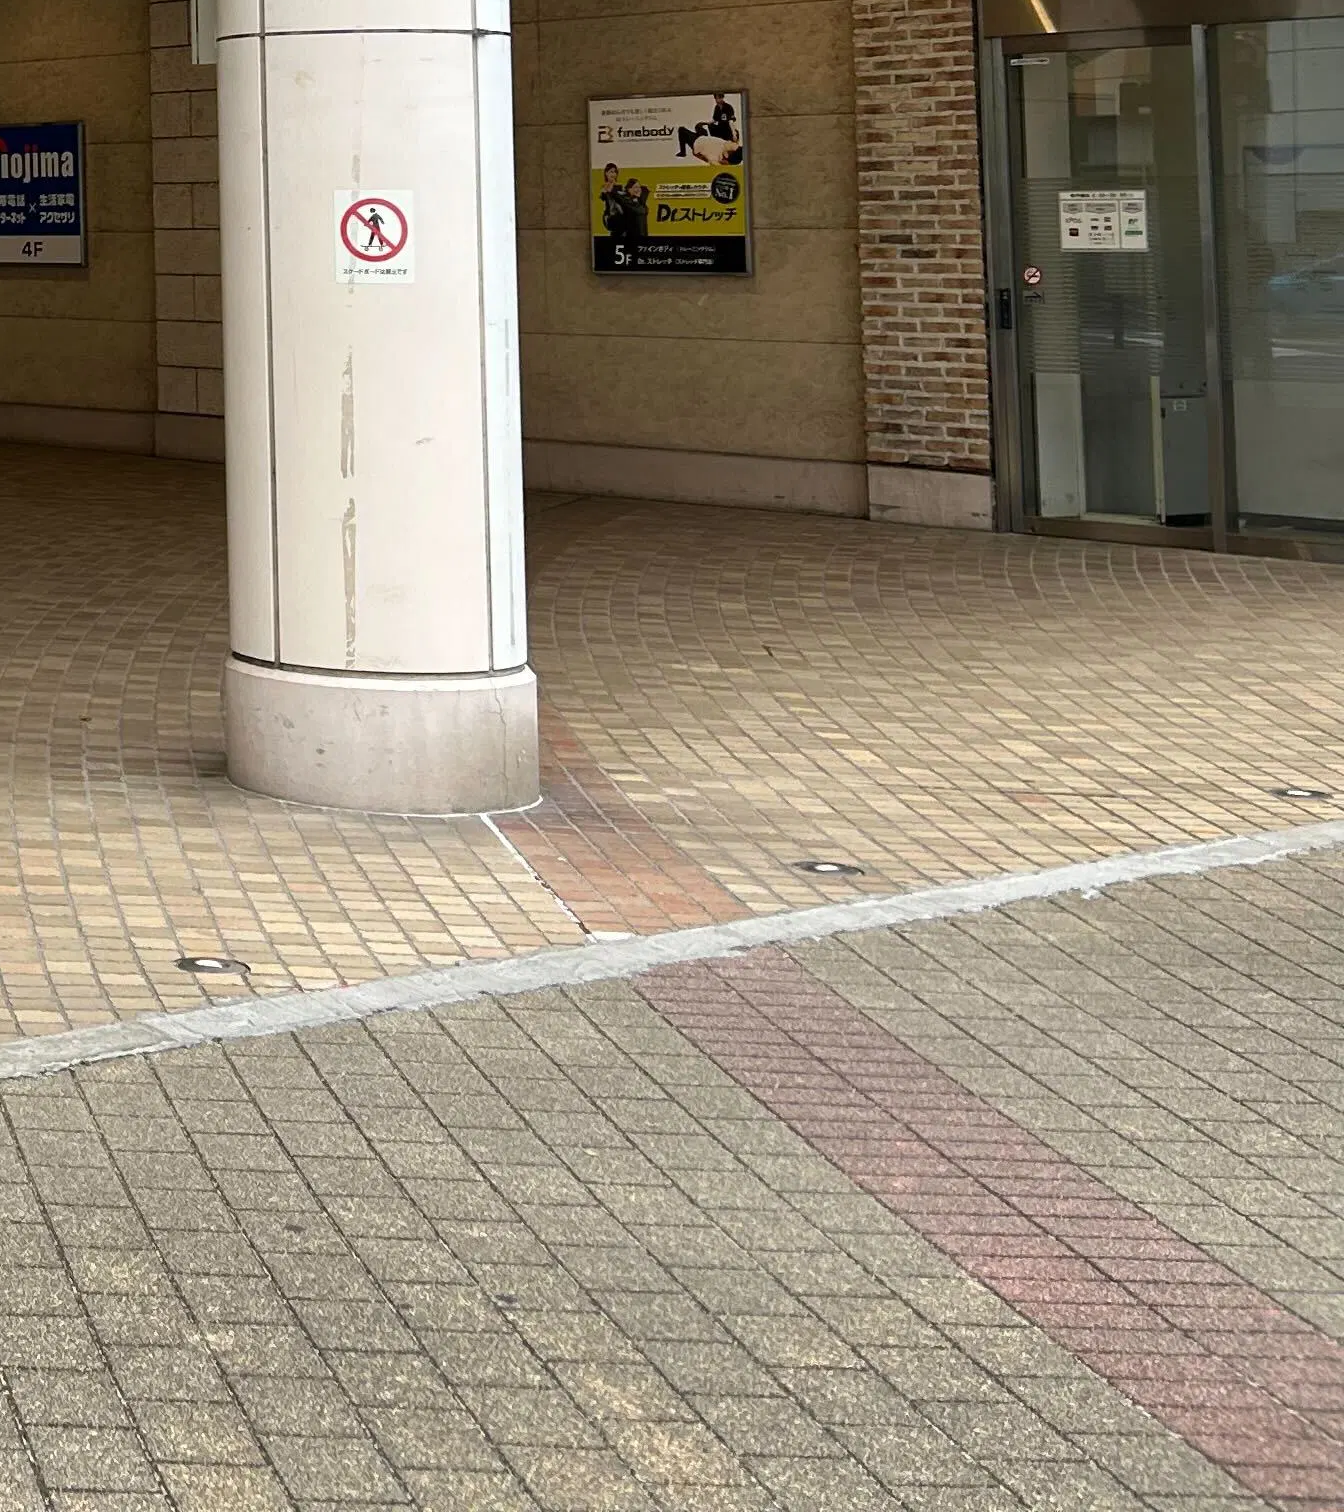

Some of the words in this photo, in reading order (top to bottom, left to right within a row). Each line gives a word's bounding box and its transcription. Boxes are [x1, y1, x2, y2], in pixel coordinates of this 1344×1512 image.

[617, 125, 674, 137] finebody
[22, 242, 43, 257] 4F
[614, 245, 632, 265] 5F
